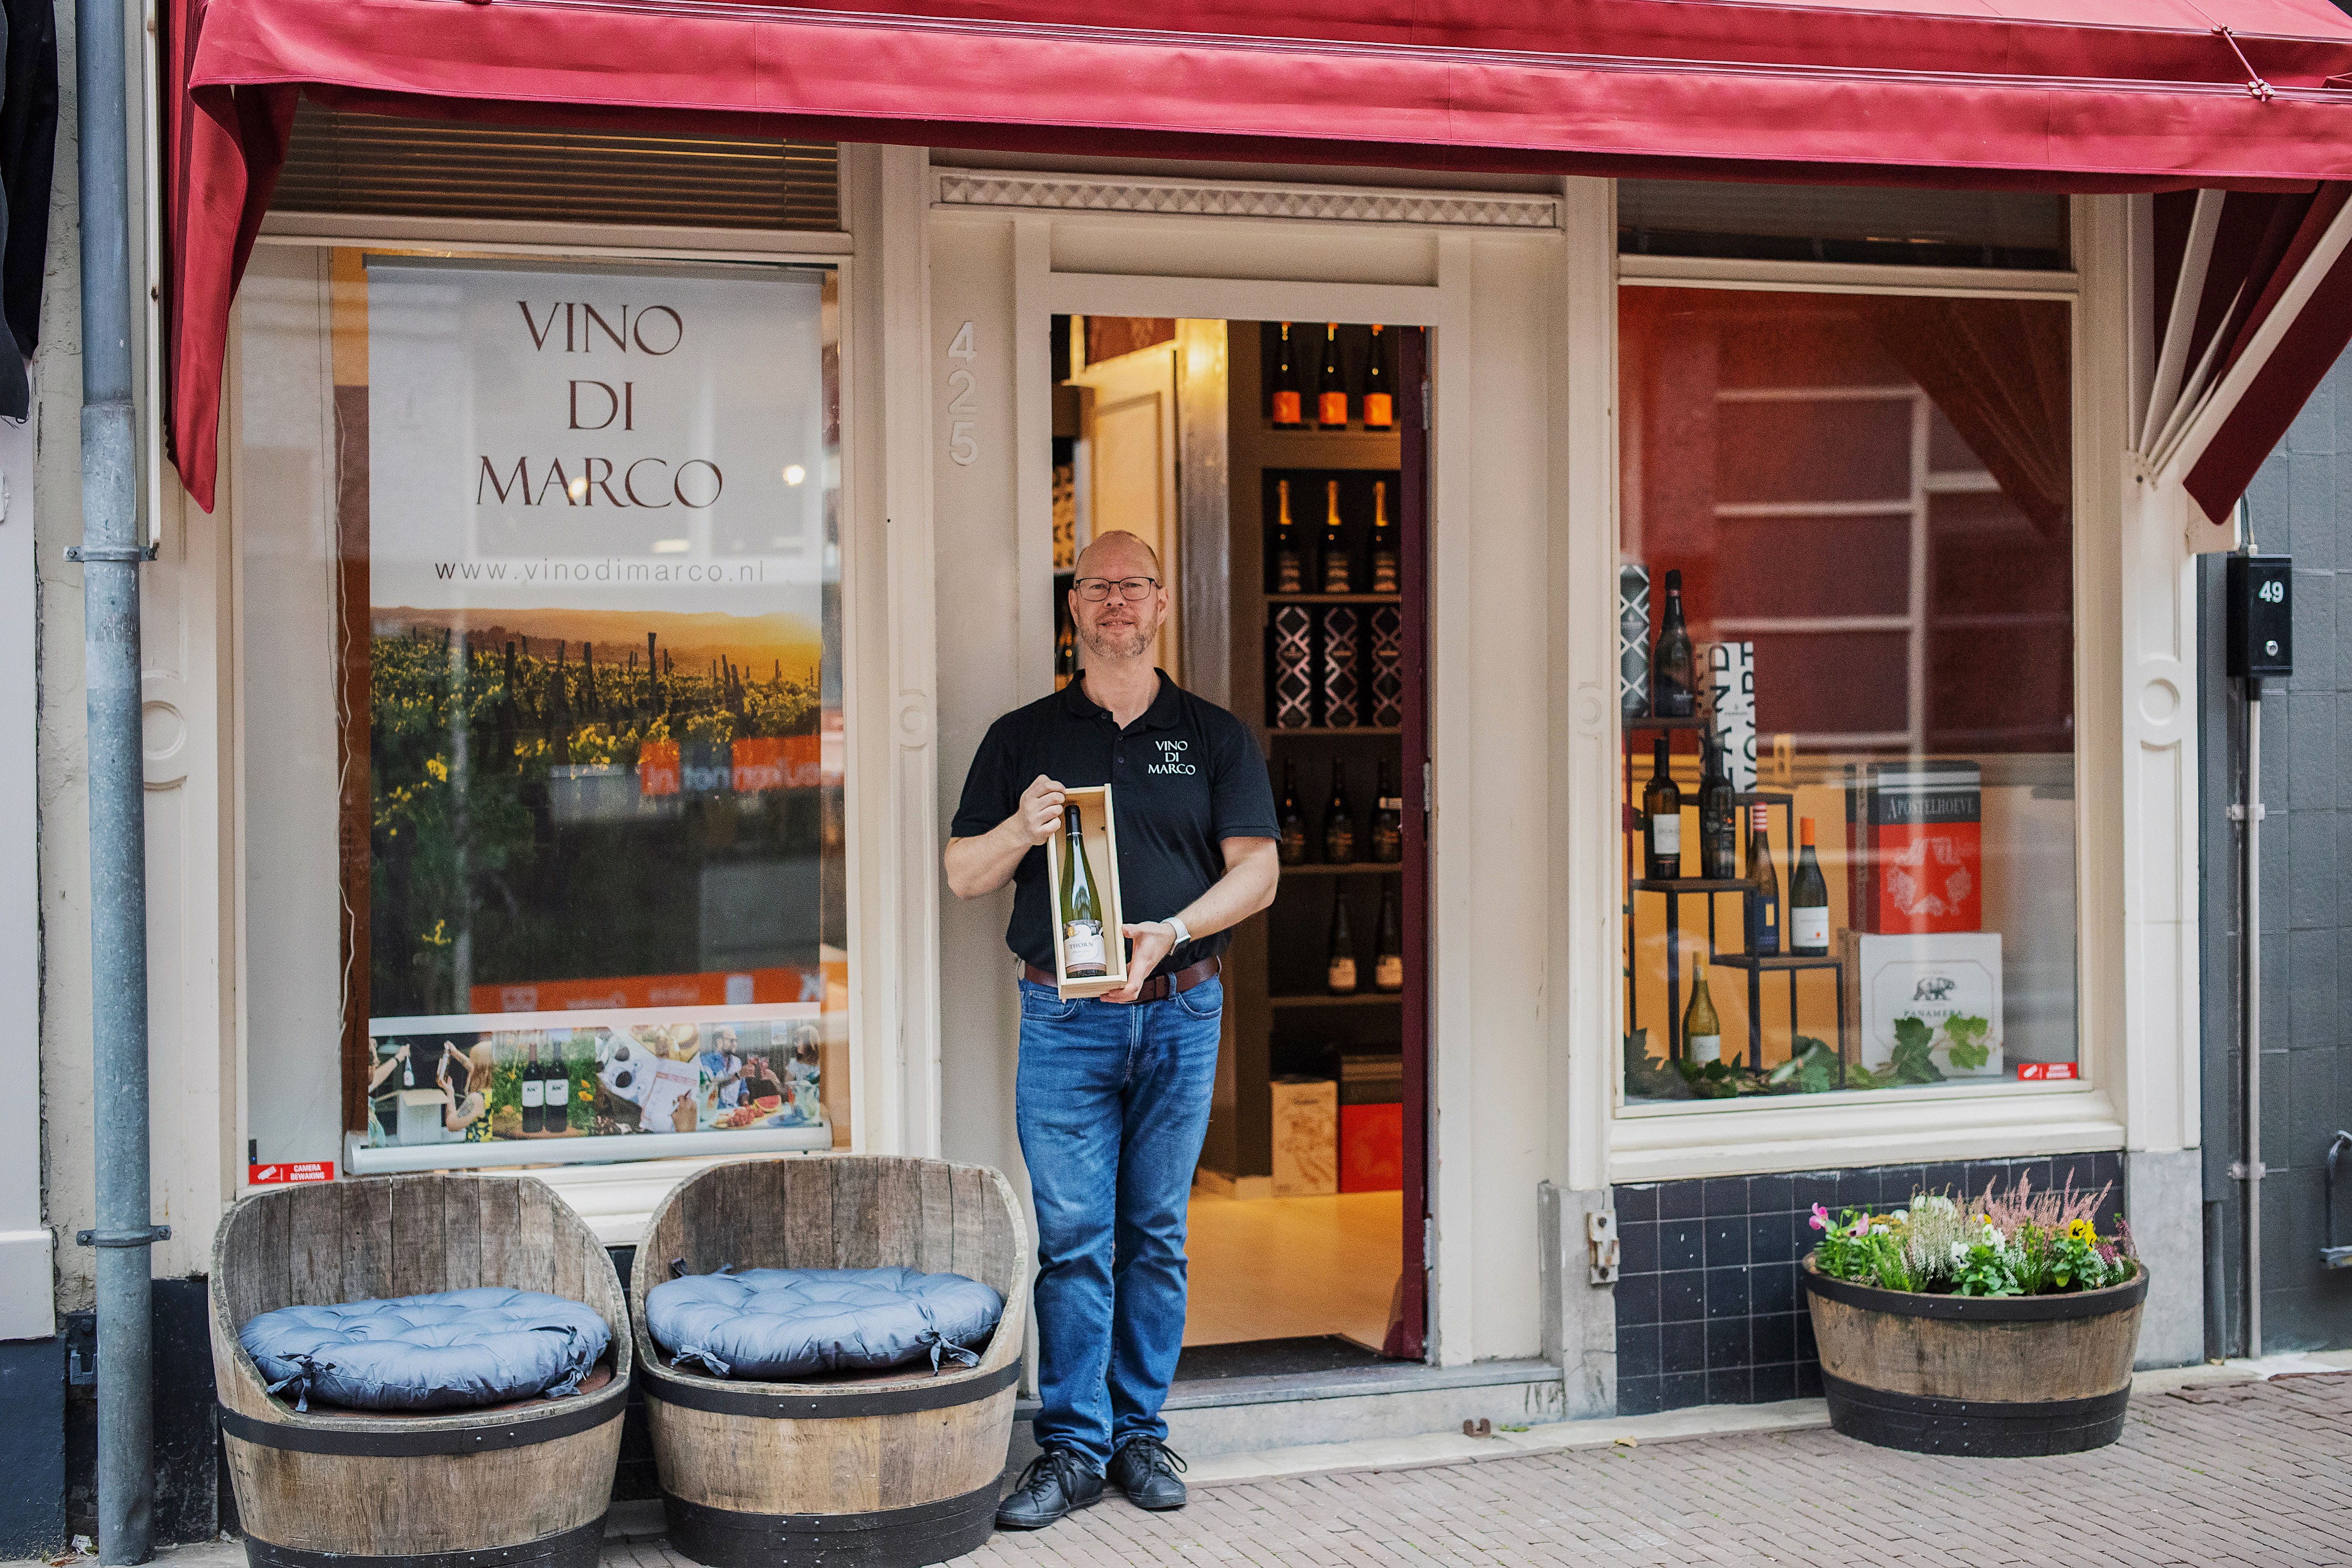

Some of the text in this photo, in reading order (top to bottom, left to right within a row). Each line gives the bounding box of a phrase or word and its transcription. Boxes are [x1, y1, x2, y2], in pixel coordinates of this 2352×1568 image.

[517, 301, 683, 355] VINO
[568, 379, 635, 431] DI
[948, 320, 978, 467] 425
[475, 455, 723, 509] MARCO
[435, 558, 763, 581] www.vinodimarco.nl
[2258, 580, 2284, 603] 49
[1155, 741, 1188, 751] VINO
[1165, 752, 1179, 763] DI
[1148, 764, 1196, 775] MARCO
[290, 1171, 325, 1181] BEWAKING
[293, 1163, 321, 1173] CAMERA
